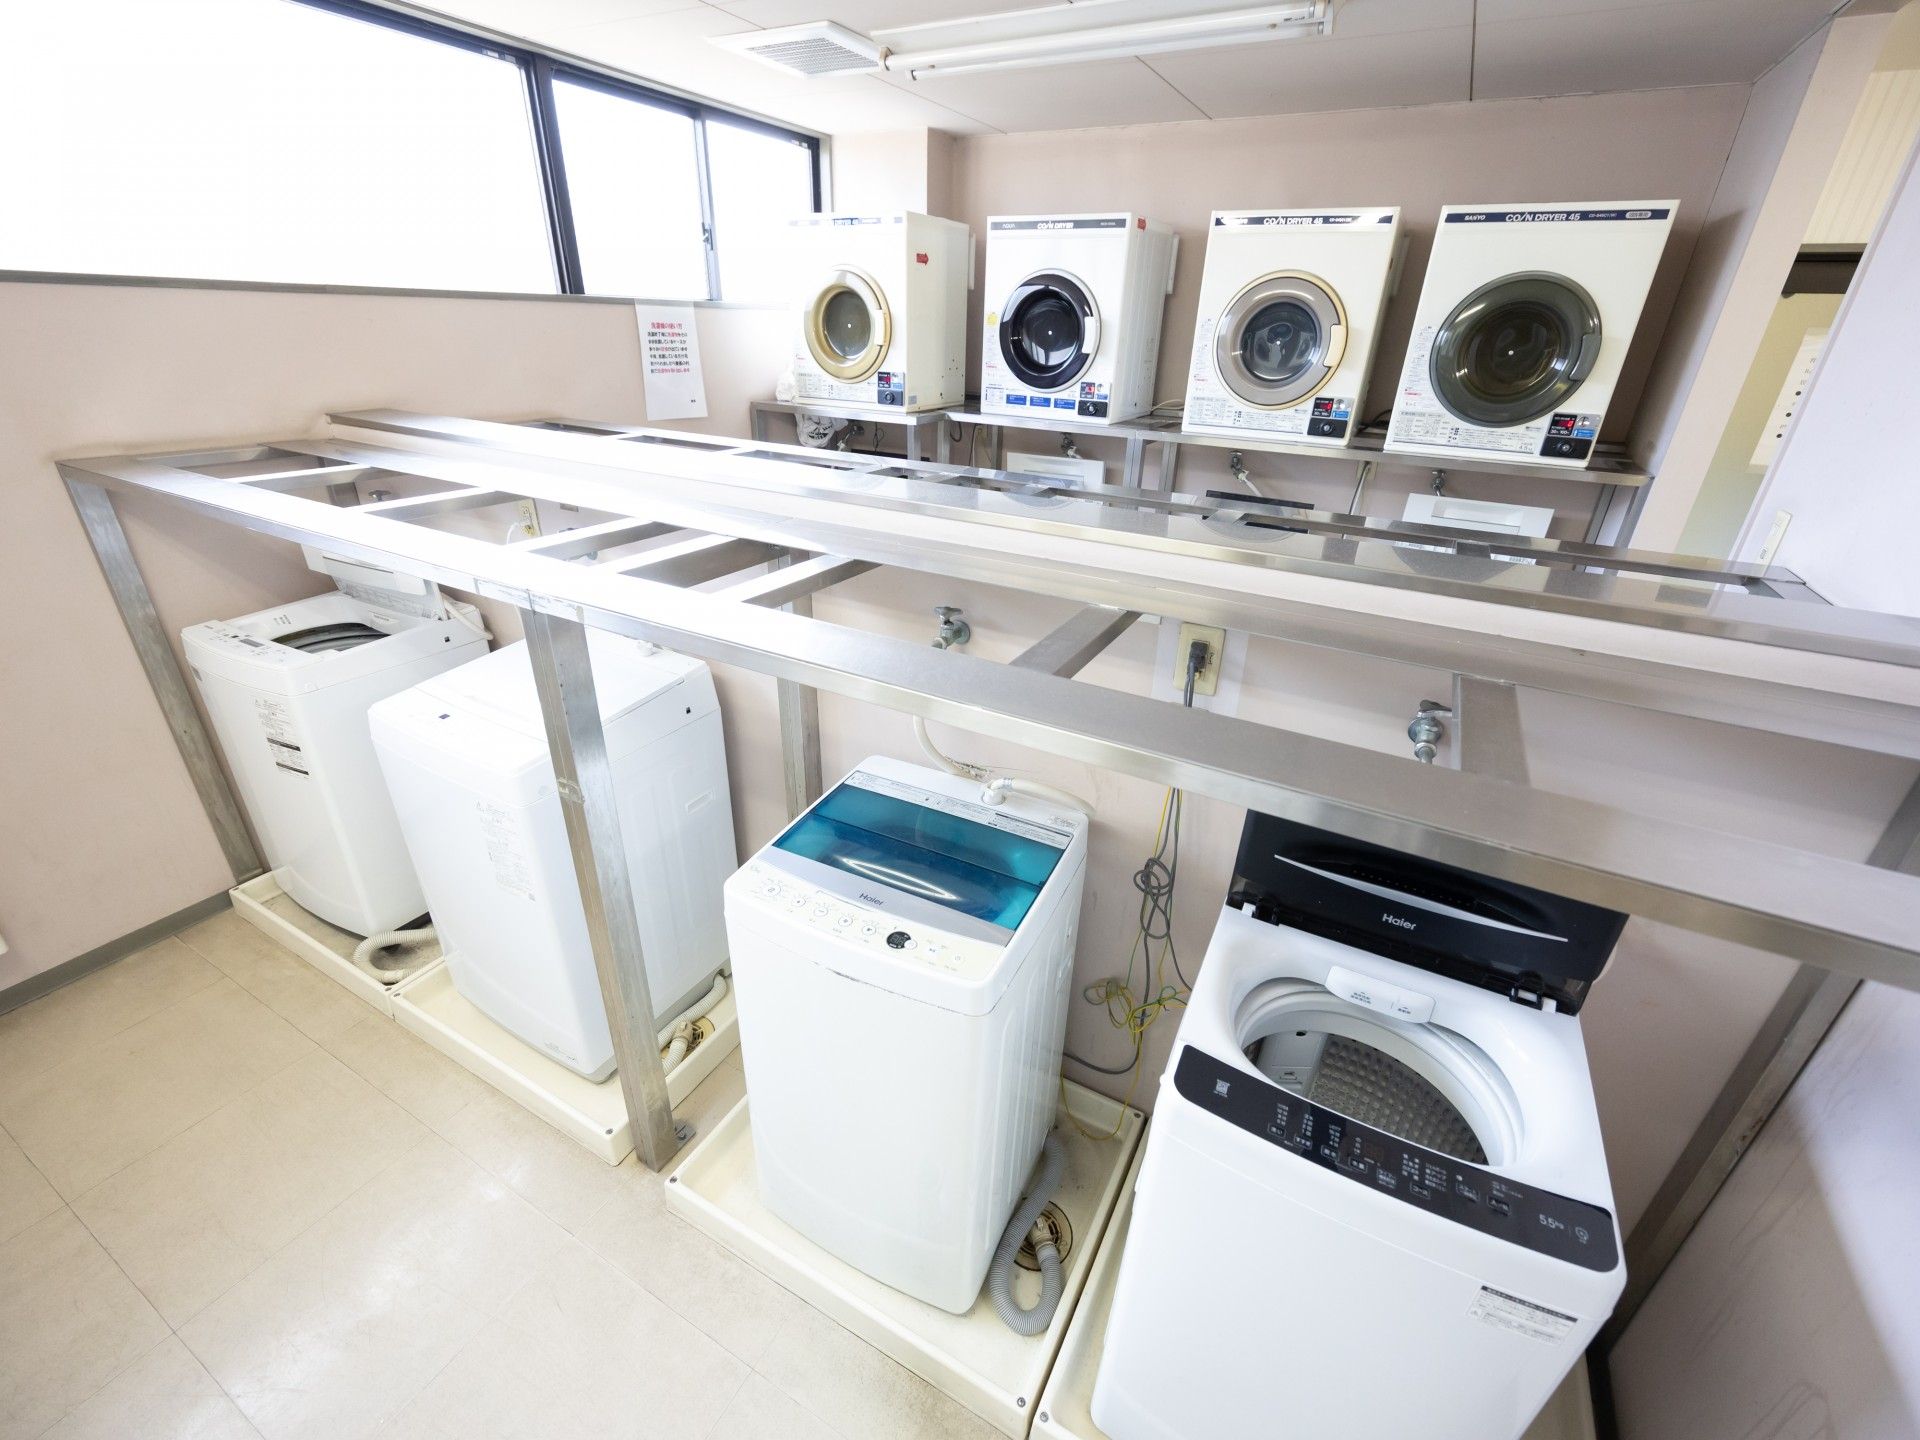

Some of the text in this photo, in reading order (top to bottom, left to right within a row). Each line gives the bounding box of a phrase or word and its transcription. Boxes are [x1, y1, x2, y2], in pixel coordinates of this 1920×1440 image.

[1286, 216, 1312, 225] DRYER
[1313, 216, 1323, 225] 45
[1464, 214, 1486, 222] SANYO
[1535, 213, 1568, 222] DRYER
[1568, 213, 1581, 221] 45
[1054, 221, 1074, 230] DRYER
[858, 892, 884, 906] Haier
[1381, 912, 1417, 931] Haier
